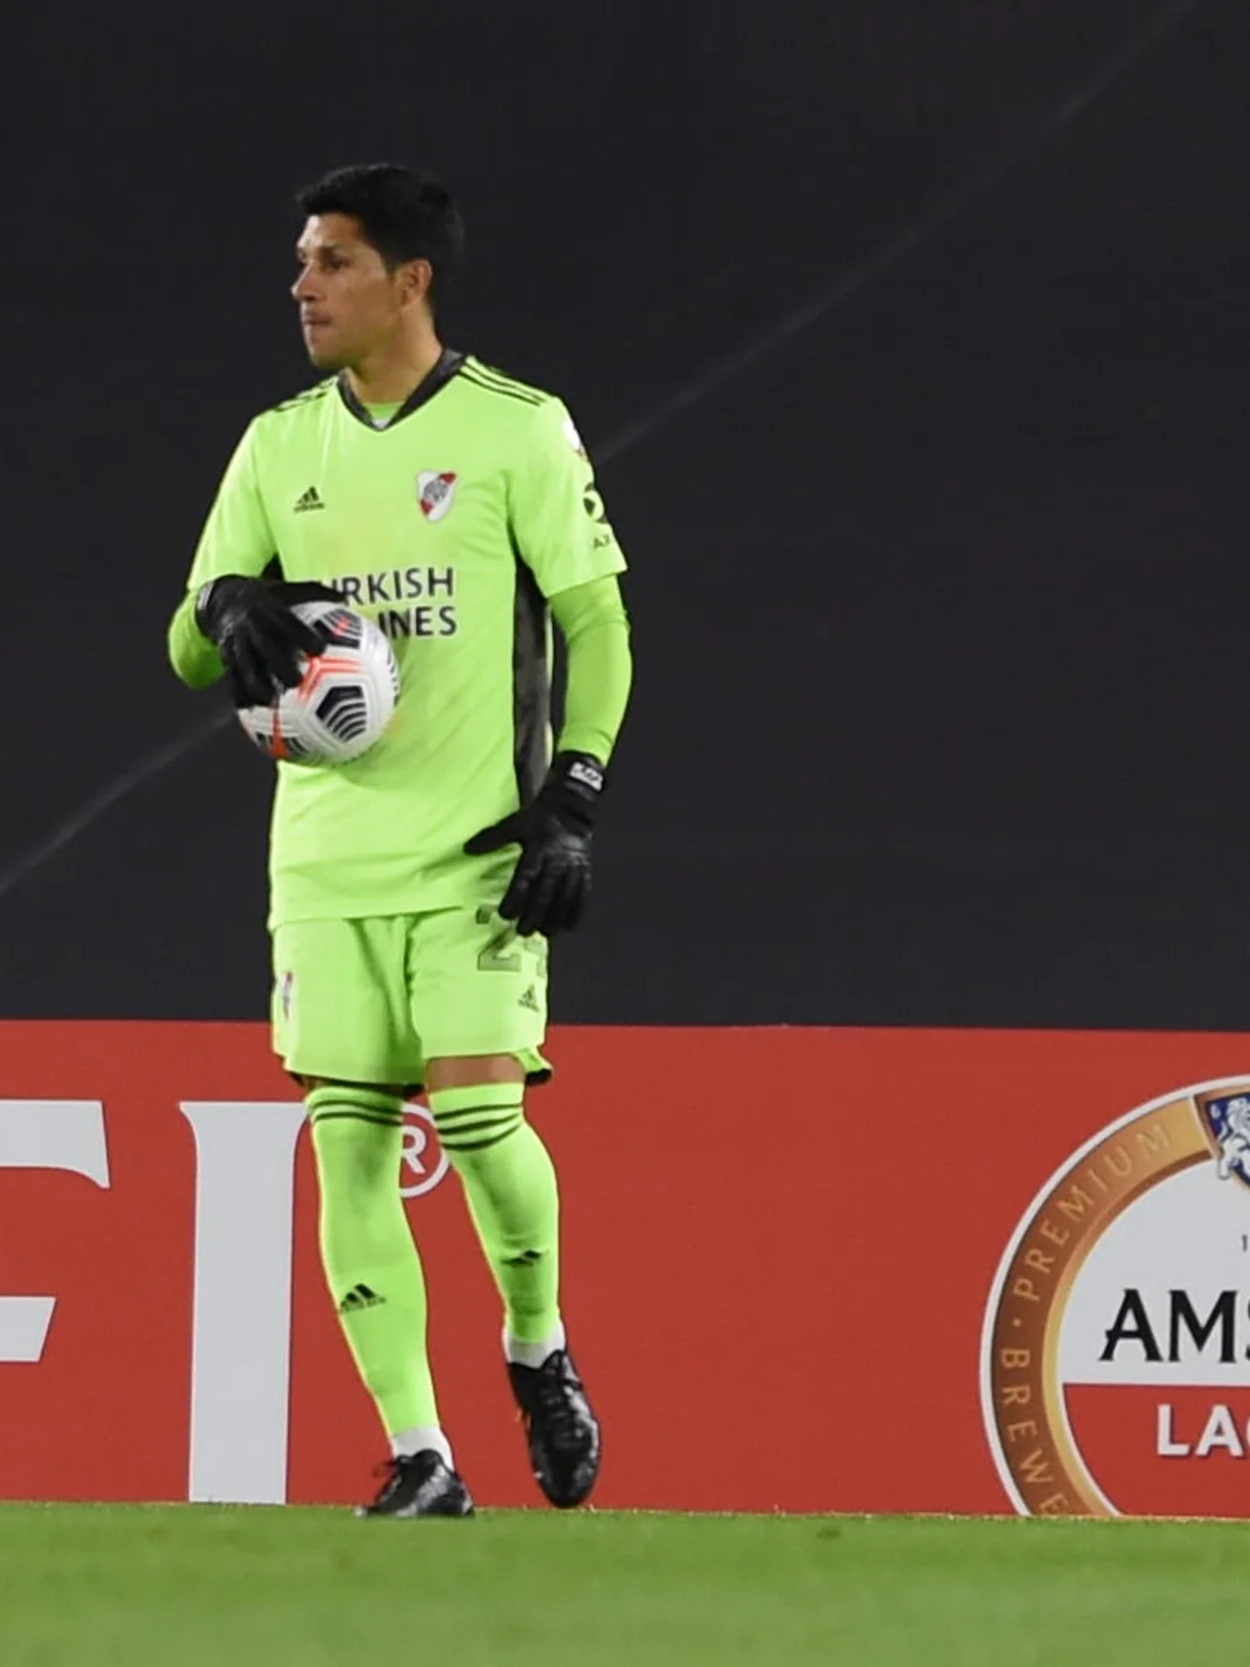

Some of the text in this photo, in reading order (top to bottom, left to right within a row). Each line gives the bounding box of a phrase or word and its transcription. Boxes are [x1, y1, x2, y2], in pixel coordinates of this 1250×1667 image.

[1013, 1123, 1172, 1302] PREMIUM
[1098, 1288, 1250, 1363] AM
[1157, 1403, 1250, 1457] LA
